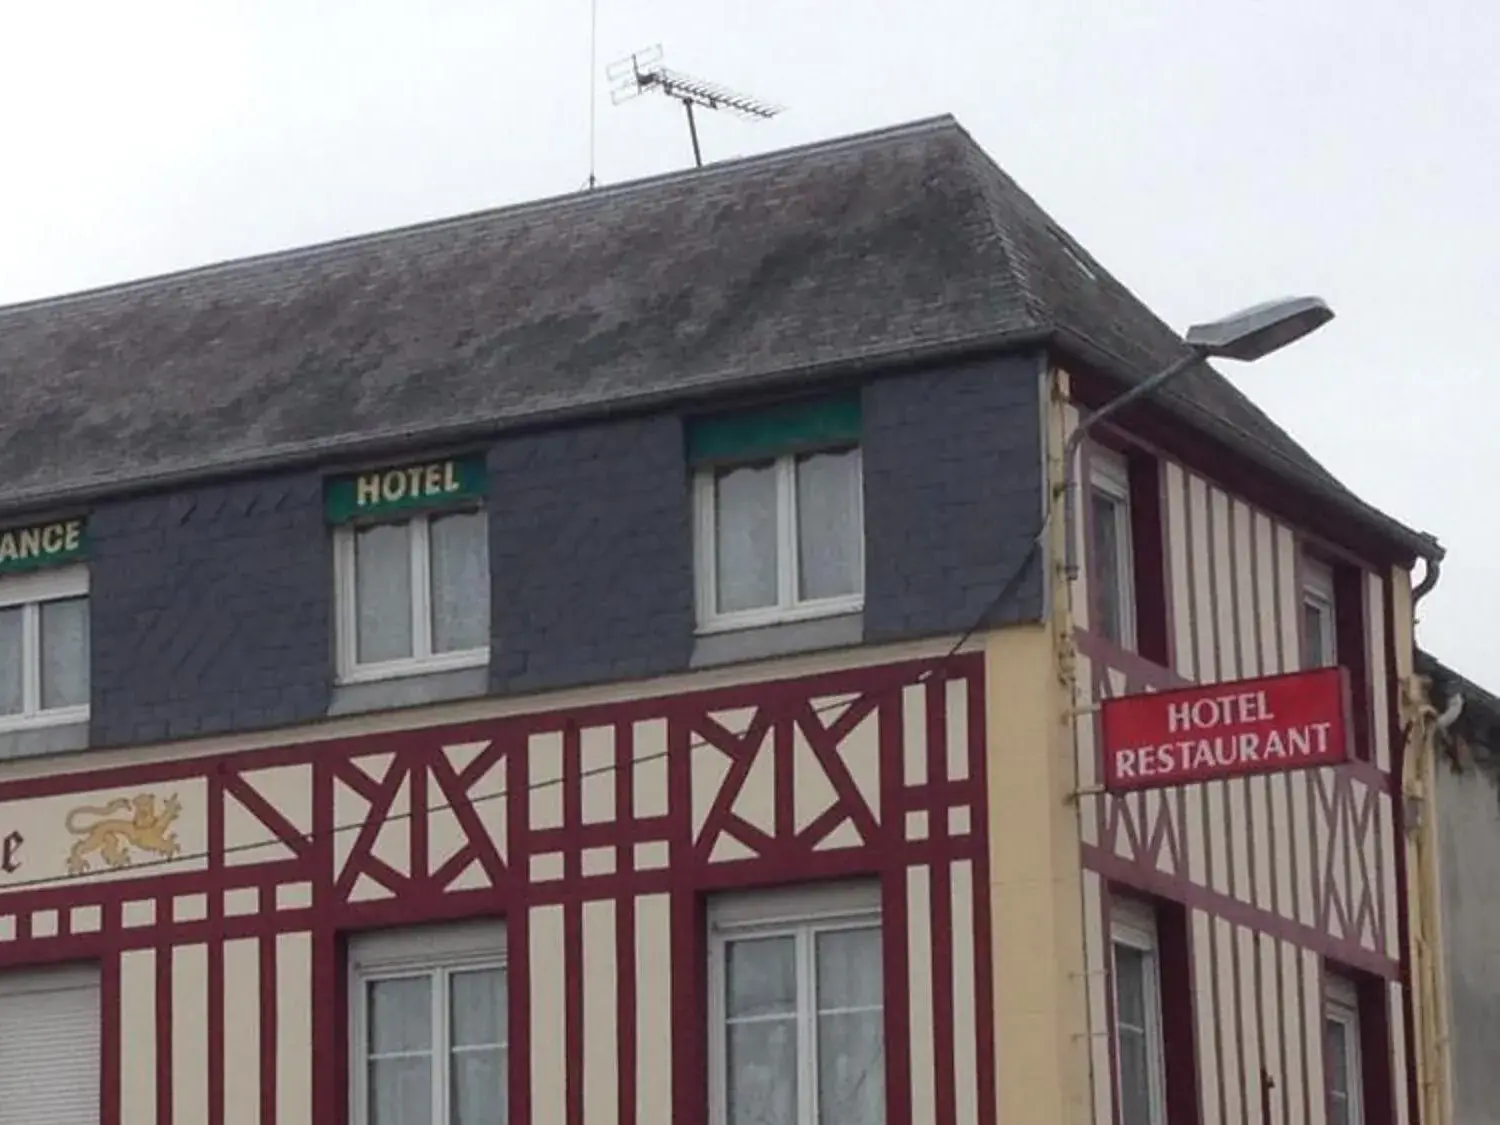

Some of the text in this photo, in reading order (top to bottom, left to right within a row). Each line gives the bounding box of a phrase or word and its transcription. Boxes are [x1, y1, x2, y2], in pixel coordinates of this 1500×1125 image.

[355, 461, 460, 507] HOTEL
[1167, 690, 1275, 733] HOTEL
[1115, 721, 1332, 778] RESTAURANT
